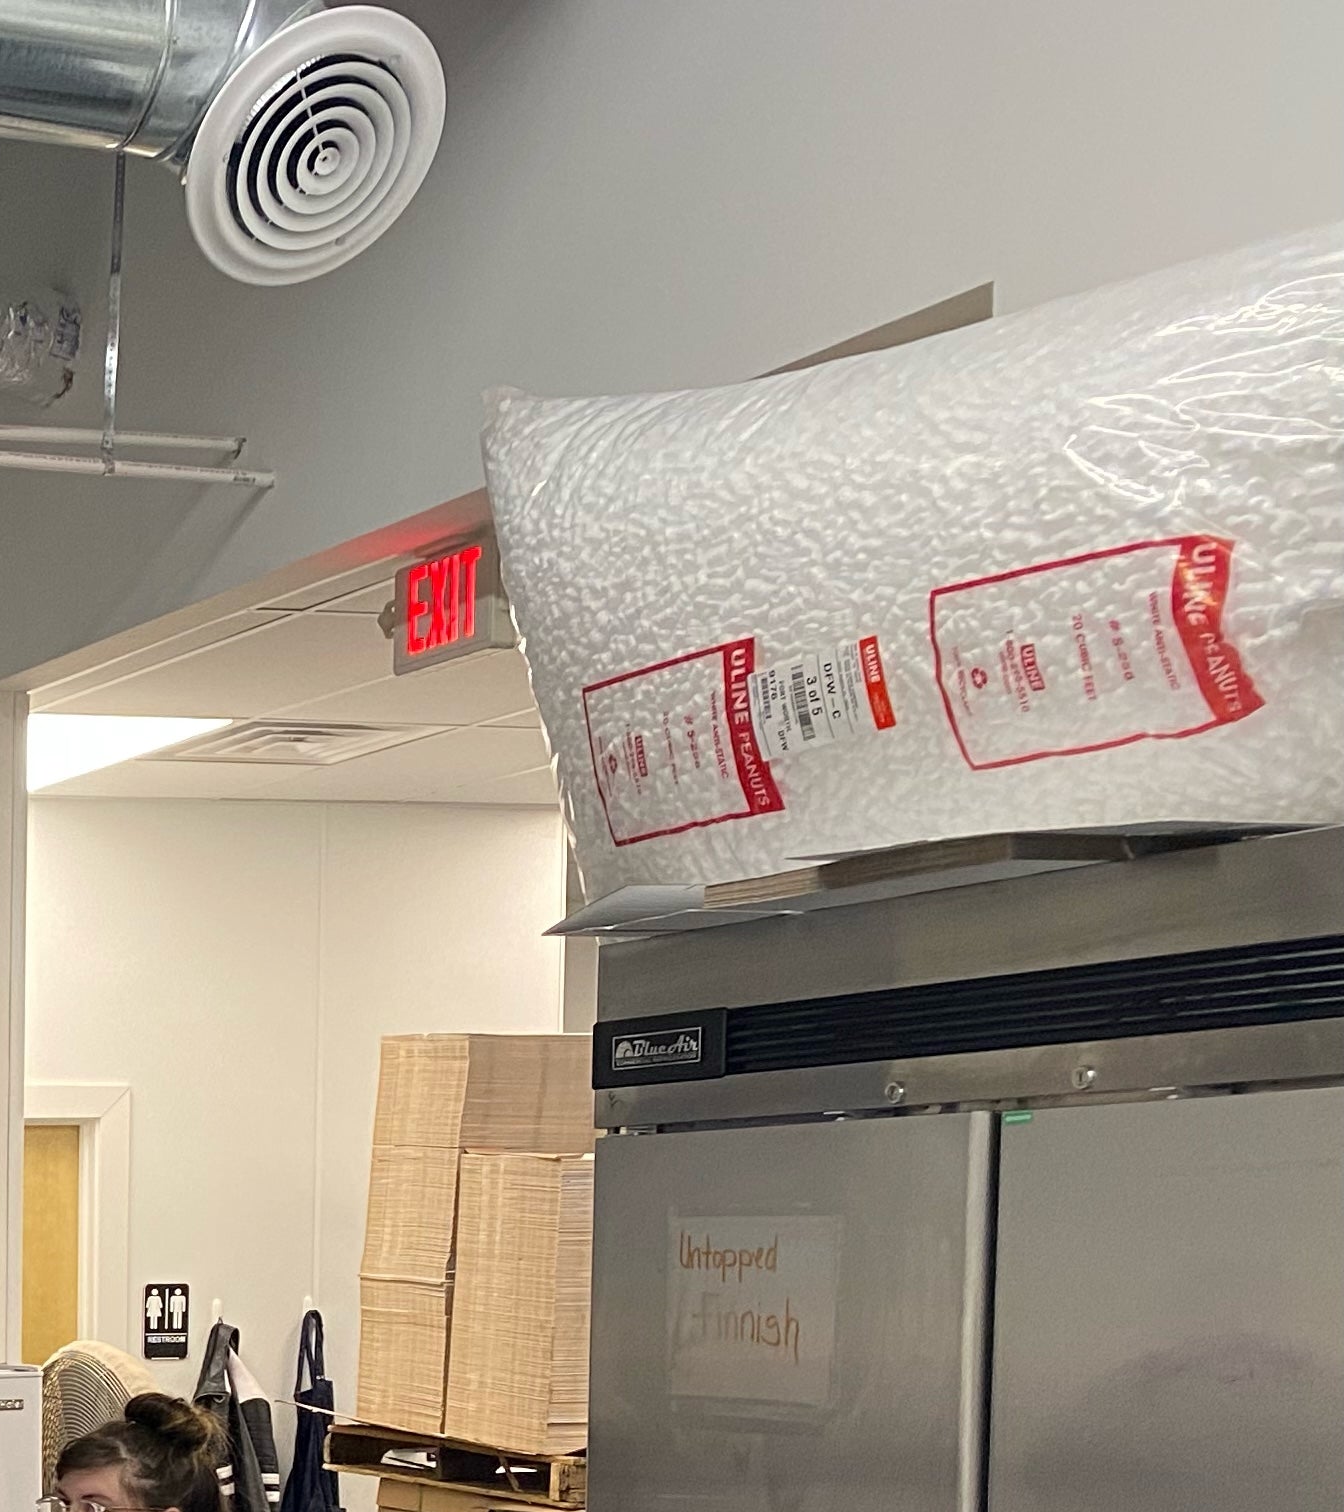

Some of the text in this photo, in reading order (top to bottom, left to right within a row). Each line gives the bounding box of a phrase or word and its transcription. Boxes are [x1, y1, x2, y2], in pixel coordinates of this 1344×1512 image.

[408, 546, 482, 655] EXIT
[1183, 542, 1243, 714] ULINE PEANUTS
[823, 662, 837, 695] DFW
[865, 644, 881, 684] ULINE
[1022, 645, 1043, 690] ULINE
[1071, 613, 1098, 702] 20 CUBIC FEET
[806, 676, 824, 717] 3 of 5
[729, 647, 771, 807] ULINE PEANUTS
[777, 730, 790, 751] DFW
[635, 736, 648, 776] ULINE
